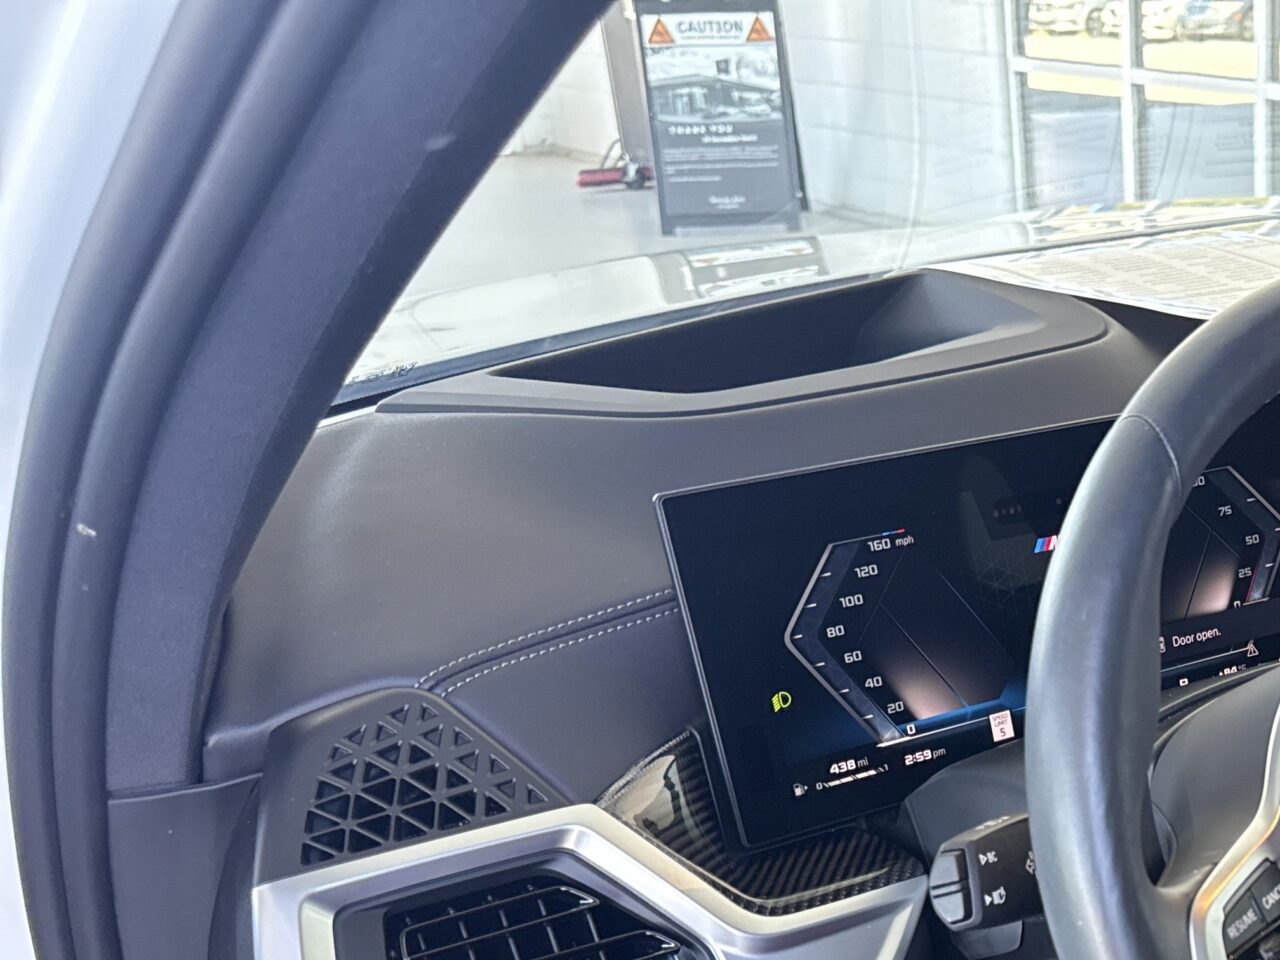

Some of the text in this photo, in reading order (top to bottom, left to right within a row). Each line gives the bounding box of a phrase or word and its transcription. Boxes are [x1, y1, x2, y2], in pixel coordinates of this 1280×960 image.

[676, 20, 743, 34] CAUTION
[1218, 506, 1232, 516] 75
[867, 536, 914, 552] 160 mph
[1246, 534, 1260, 545] 50
[854, 564, 878, 578] 120
[1238, 567, 1252, 578] 25
[839, 594, 864, 608] 100
[826, 624, 845, 638] 80
[1172, 627, 1222, 648] Door open.
[844, 650, 862, 664] 60
[864, 676, 883, 688] 40
[887, 702, 904, 714] 20
[992, 713, 1008, 721] SPEED
[907, 724, 916, 735] 0
[1000, 728, 1006, 737] 5
[904, 748, 946, 766] 2:59 pm
[830, 758, 869, 774] 438 mi
[987, 851, 998, 863] BC
[1226, 908, 1258, 940] RESUME
